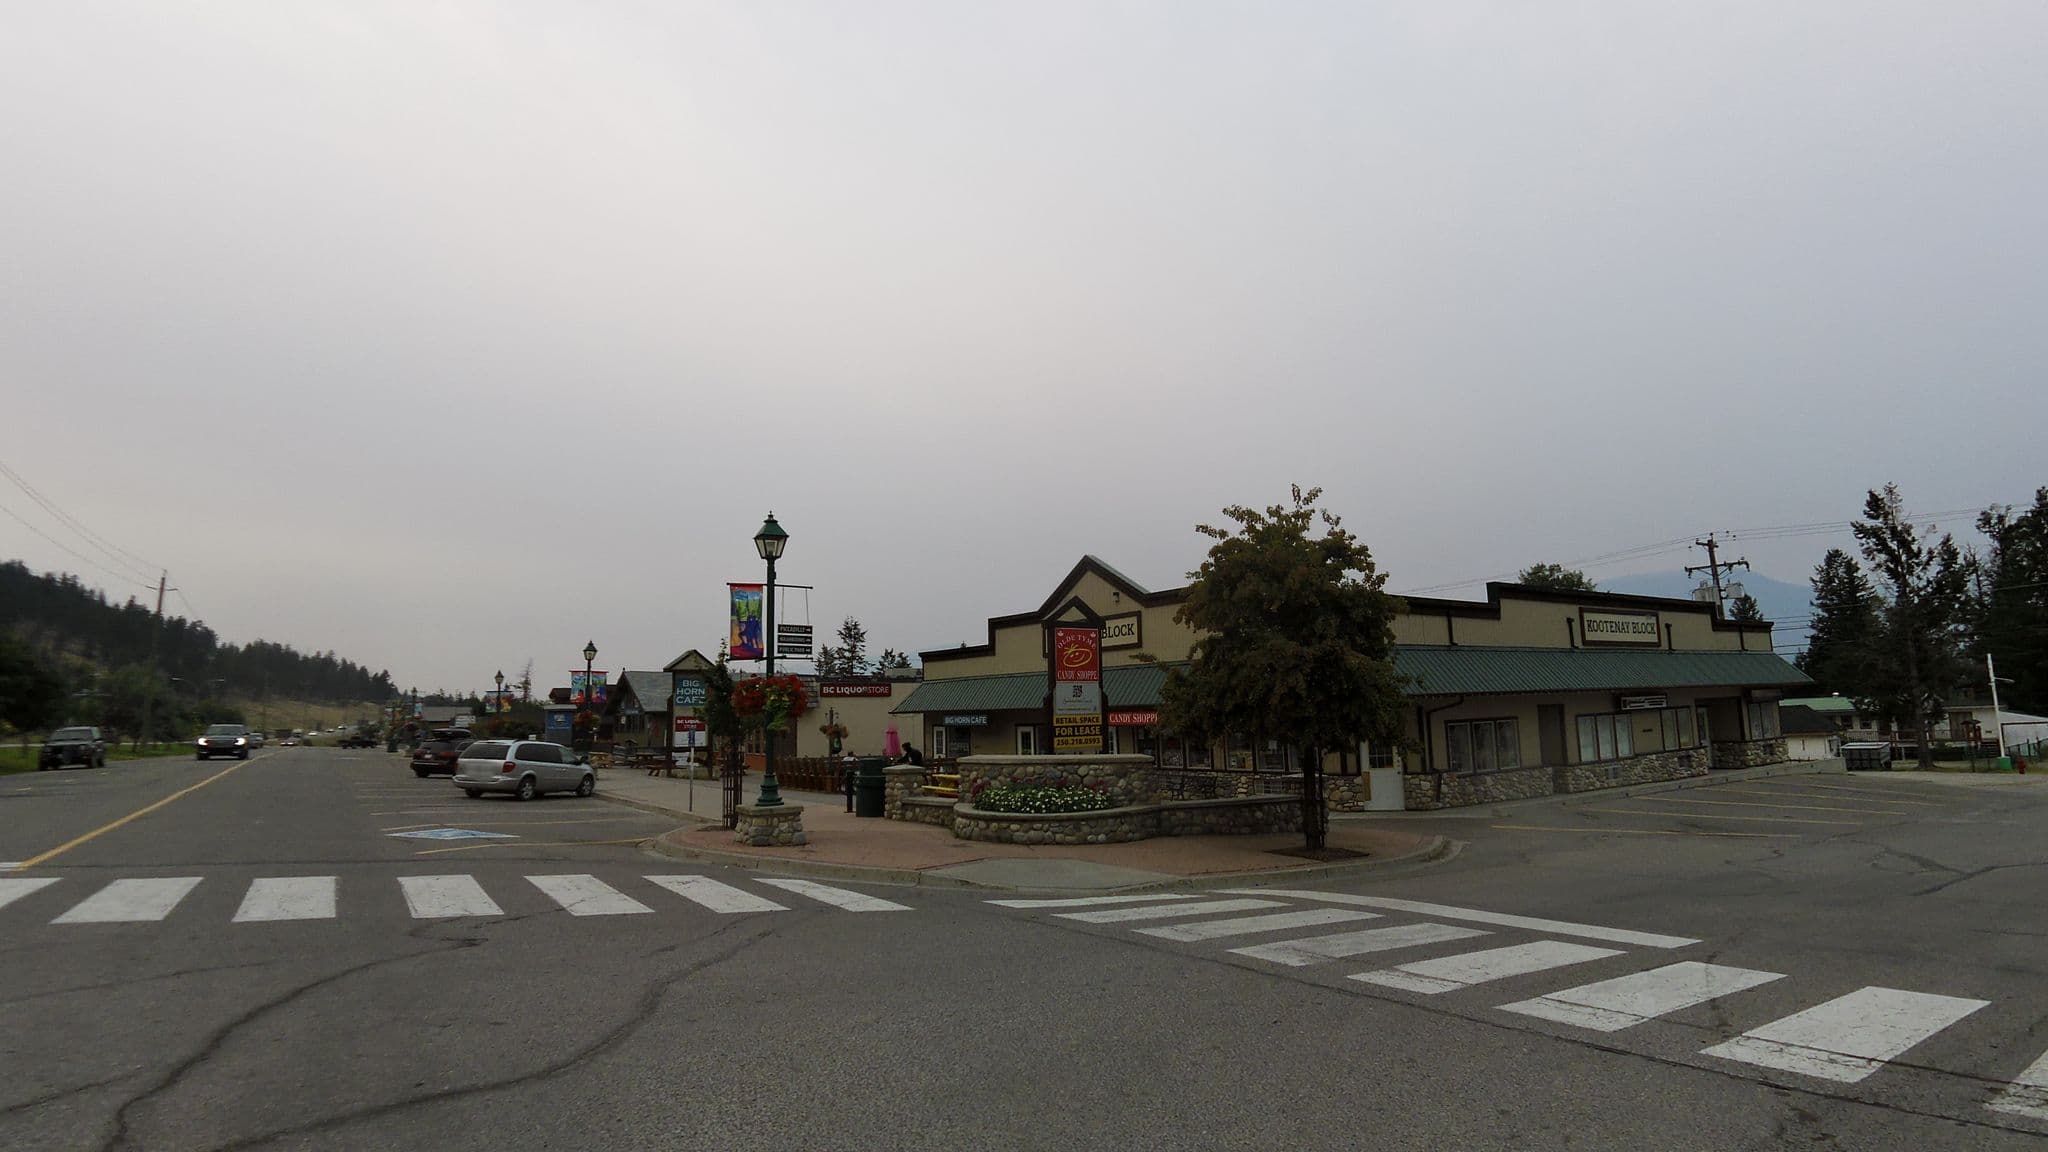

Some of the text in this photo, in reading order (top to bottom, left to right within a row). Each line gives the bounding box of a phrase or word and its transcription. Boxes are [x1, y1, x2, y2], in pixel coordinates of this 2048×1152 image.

[1101, 623, 1134, 639] BLOCK
[1587, 620, 1656, 634] KOOTENAY BLOCK
[1057, 634, 1097, 650] OLDE TYME
[1057, 670, 1097, 680] CANDY SHOPPE
[682, 679, 700, 688] BIG
[676, 687, 705, 696] HORN
[822, 686, 835, 694] BC
[867, 686, 889, 694] STORE
[944, 716, 987, 724] BIG HORN CAFE
[1056, 716, 1100, 725] RETAIL SPACE
[1109, 713, 1132, 723] CANDY
[1055, 725, 1101, 737] FOR LEASE
